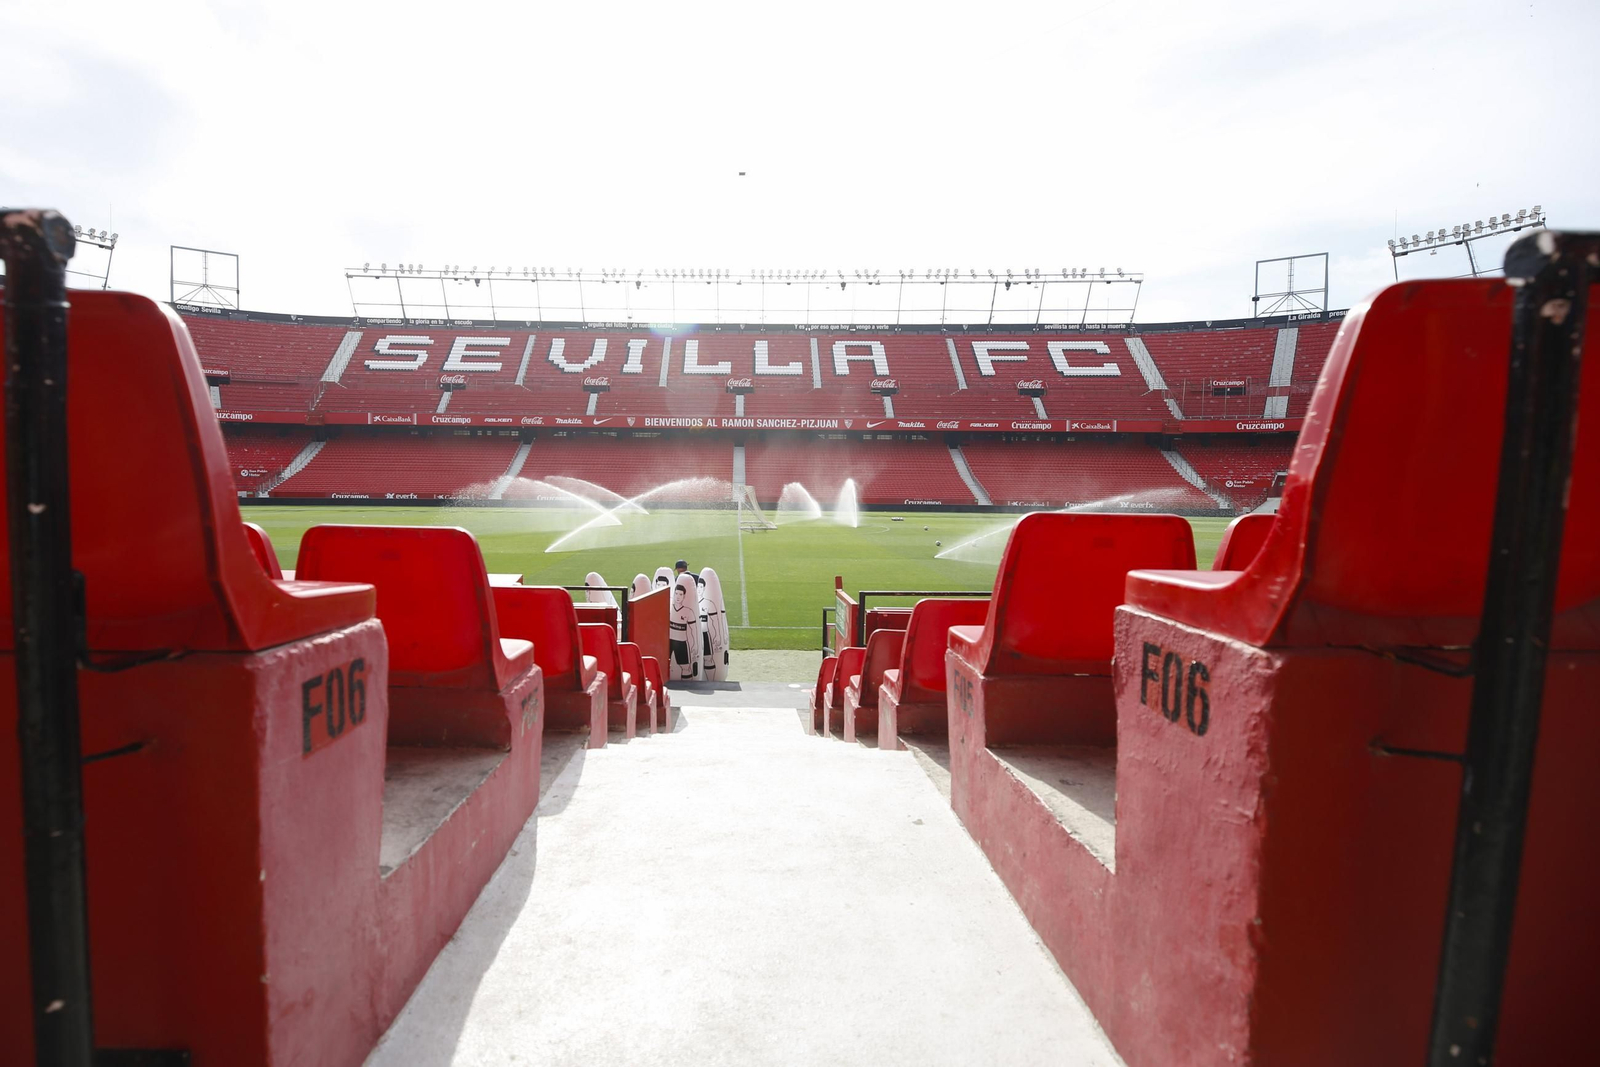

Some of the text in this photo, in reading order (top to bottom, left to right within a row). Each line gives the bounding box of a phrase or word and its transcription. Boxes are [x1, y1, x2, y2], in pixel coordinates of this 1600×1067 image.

[176, 304, 222, 314] contigo Sevilla
[364, 335, 1122, 377] SEVILLA FC
[215, 412, 253, 421] uzcampo
[381, 415, 412, 423] CaixaBank
[432, 415, 472, 424] Cruzcampo
[644, 417, 838, 428] BIENVENIDOS AL RAMON SANCHEZ-PIZJUAN
[1011, 421, 1052, 430] Cruzcampo
[1080, 422, 1112, 430] CaixaBank
[1236, 421, 1285, 431] Cruzcampo
[395, 492, 418, 500] everfx
[1139, 641, 1211, 737] F06
[302, 658, 366, 755] F06
